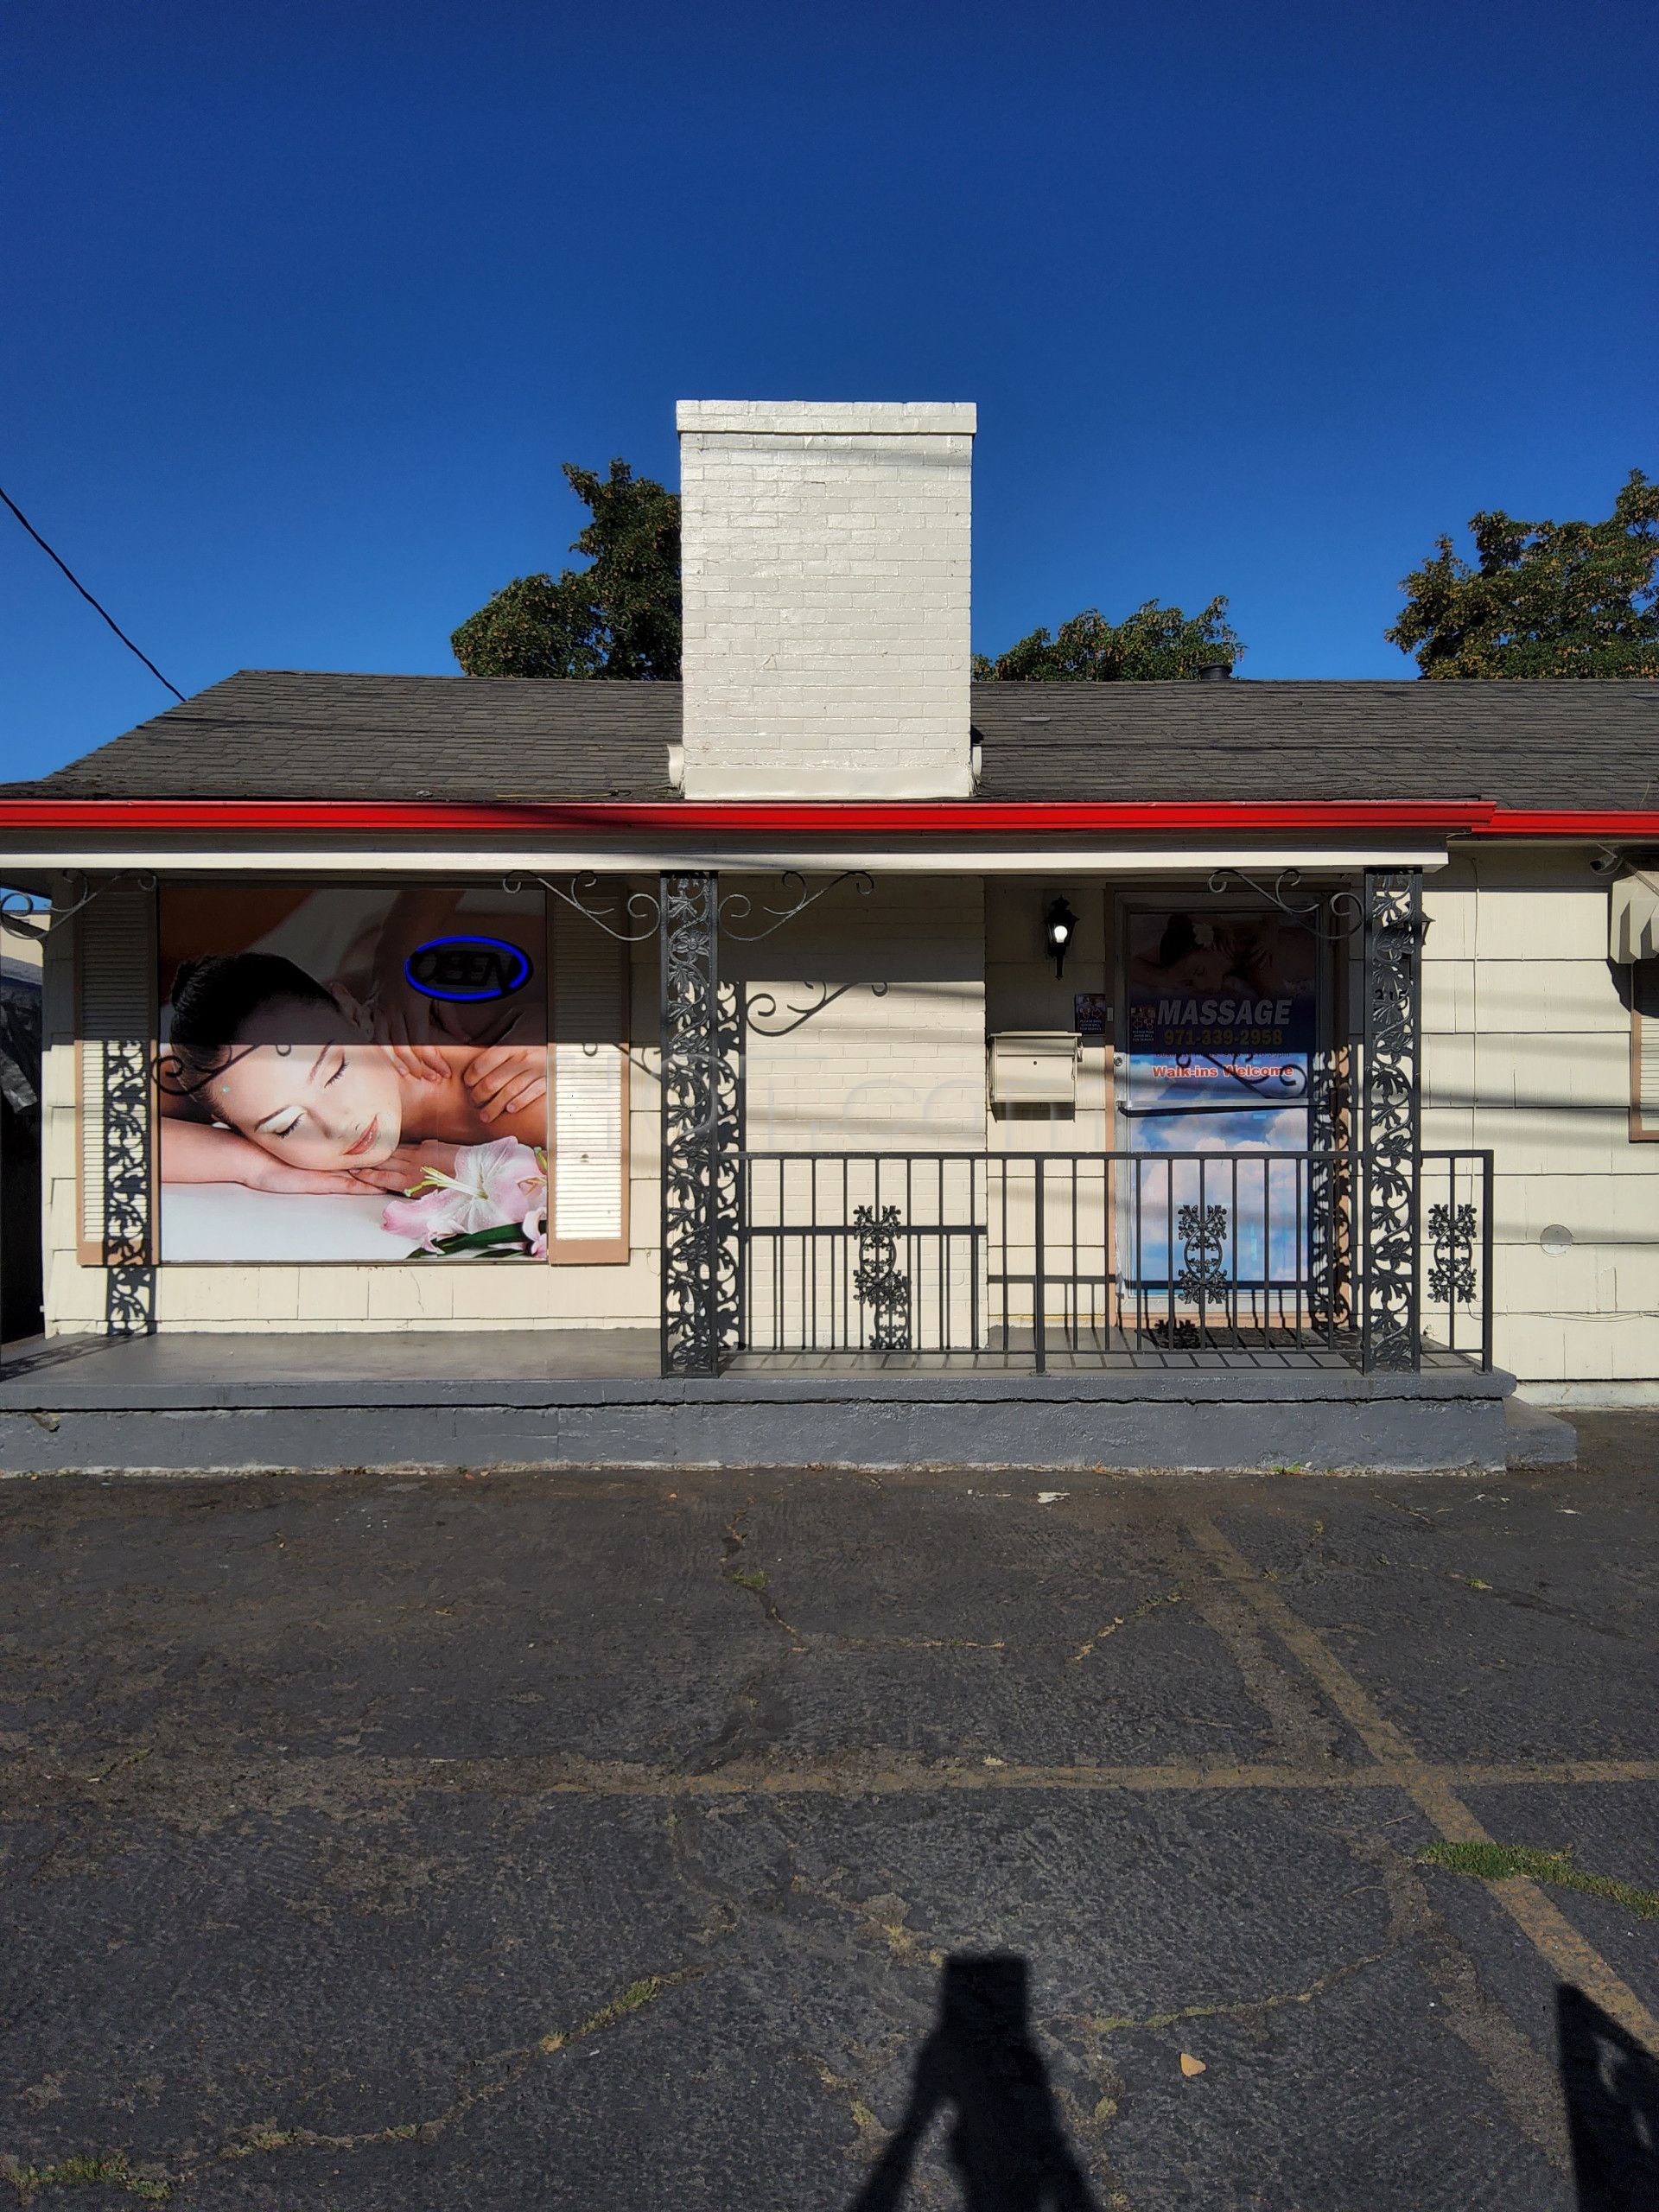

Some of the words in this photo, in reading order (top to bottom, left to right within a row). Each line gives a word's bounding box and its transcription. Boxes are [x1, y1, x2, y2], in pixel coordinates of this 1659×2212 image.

[1157, 999, 1293, 1026] MASSAGE
[1164, 1029, 1283, 1046] 971-339-2958
[1152, 1065, 1218, 1078] Walk-ins
[1223, 1064, 1294, 1077] Welcome
